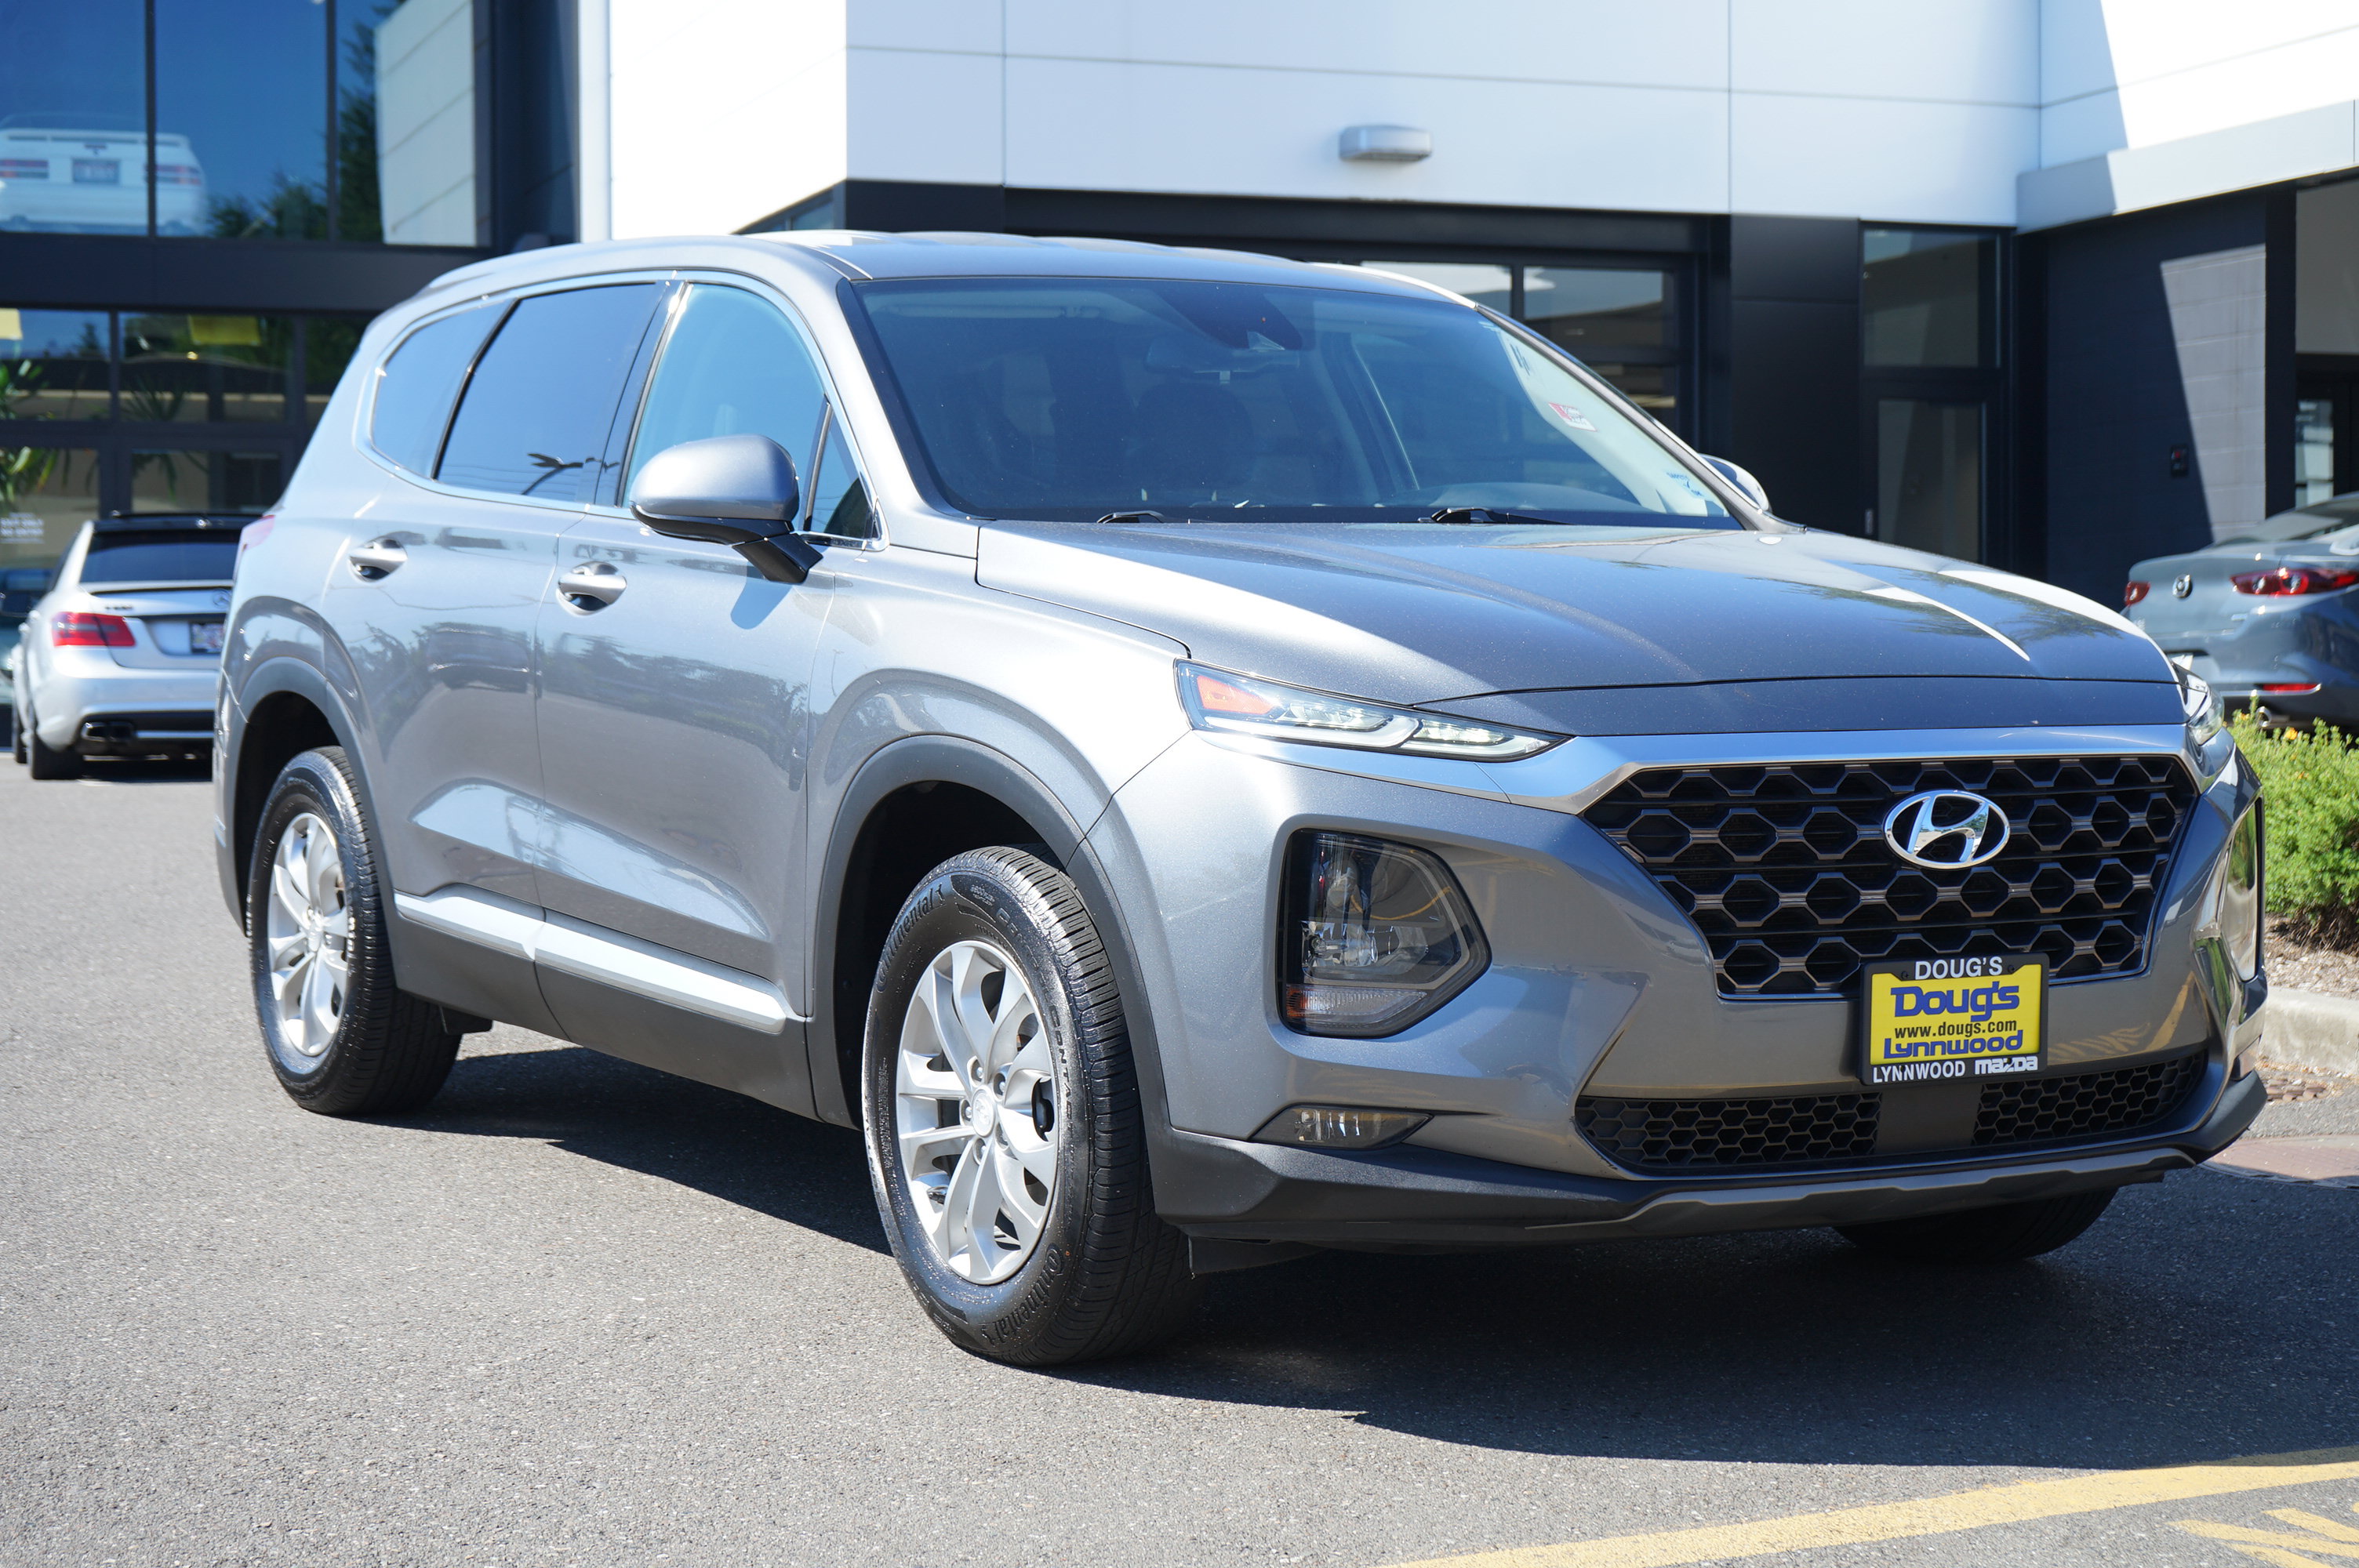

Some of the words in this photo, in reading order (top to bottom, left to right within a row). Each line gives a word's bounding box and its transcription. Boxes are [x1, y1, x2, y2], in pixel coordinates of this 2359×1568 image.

[1914, 956, 2003, 980] DOUG'S
[1891, 981, 2020, 1022] Doug's
[1895, 1020, 2017, 1039] www.dougs.com
[1884, 1029, 2023, 1059] Lynnwood
[1872, 1060, 1966, 1083] LYNNWOOD
